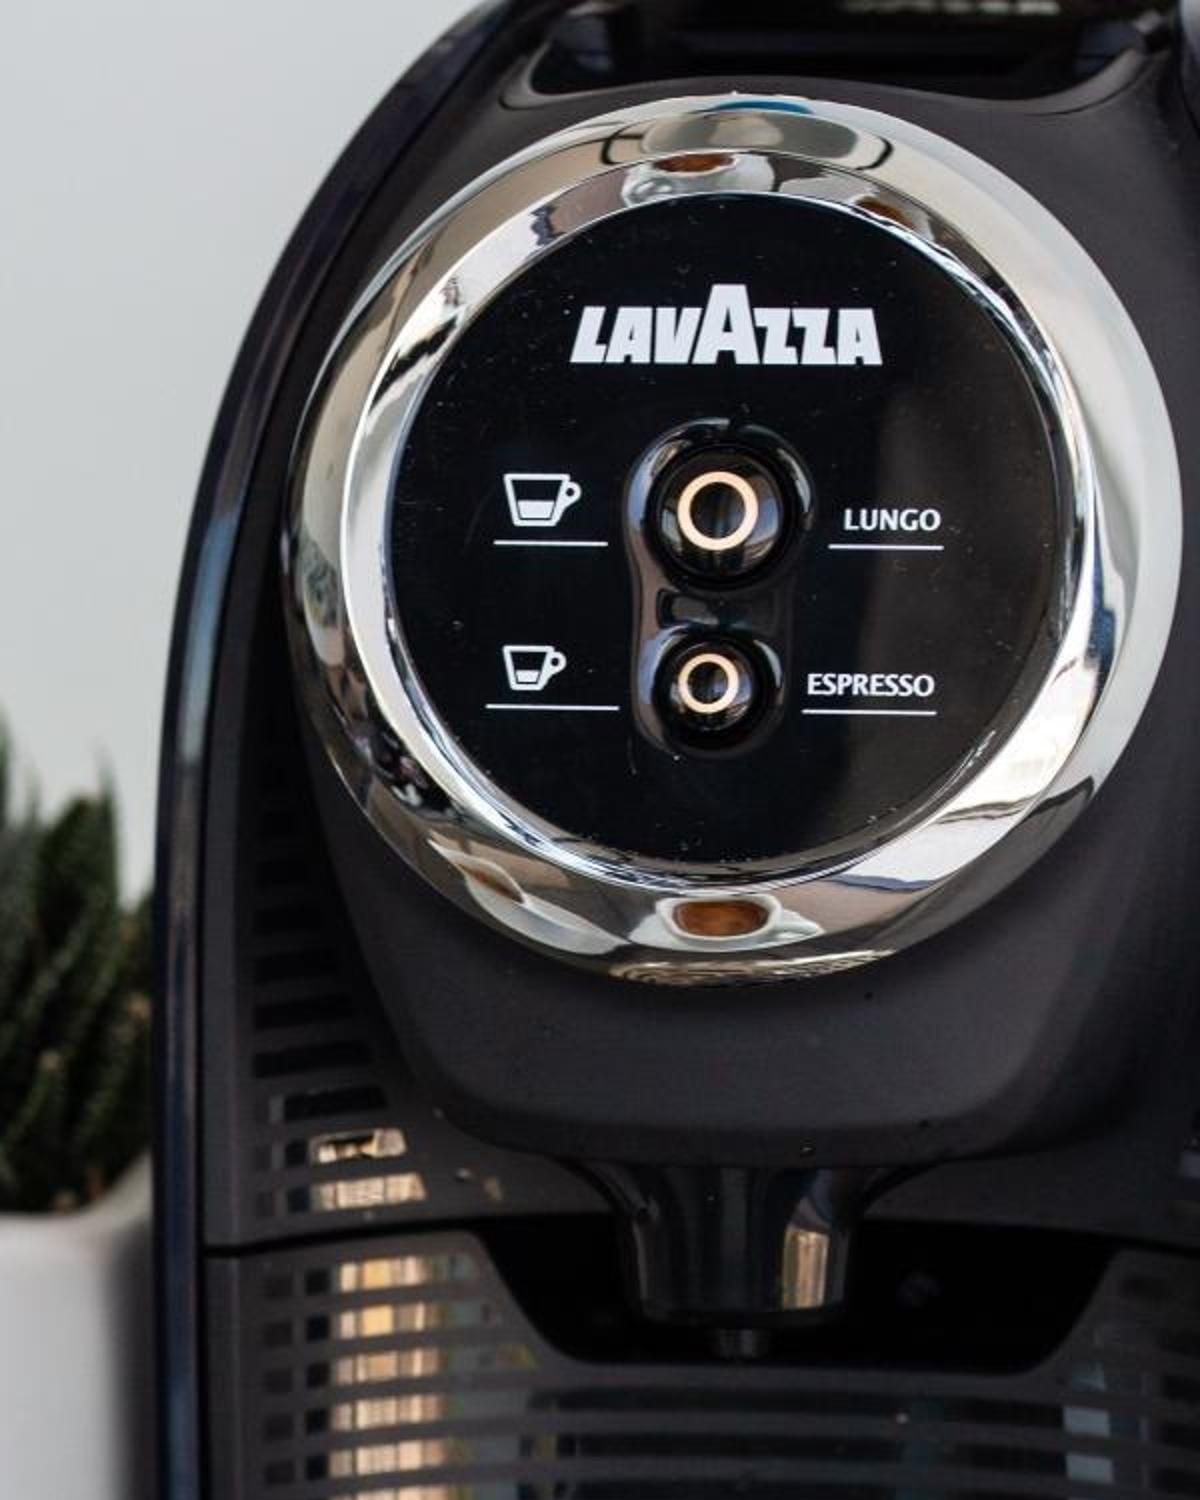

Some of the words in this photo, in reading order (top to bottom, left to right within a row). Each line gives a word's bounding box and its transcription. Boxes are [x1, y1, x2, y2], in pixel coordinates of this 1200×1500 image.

[570, 284, 883, 366] LAVAZZA
[843, 508, 942, 532] LUNGO
[806, 672, 936, 697] ESPRESSO
